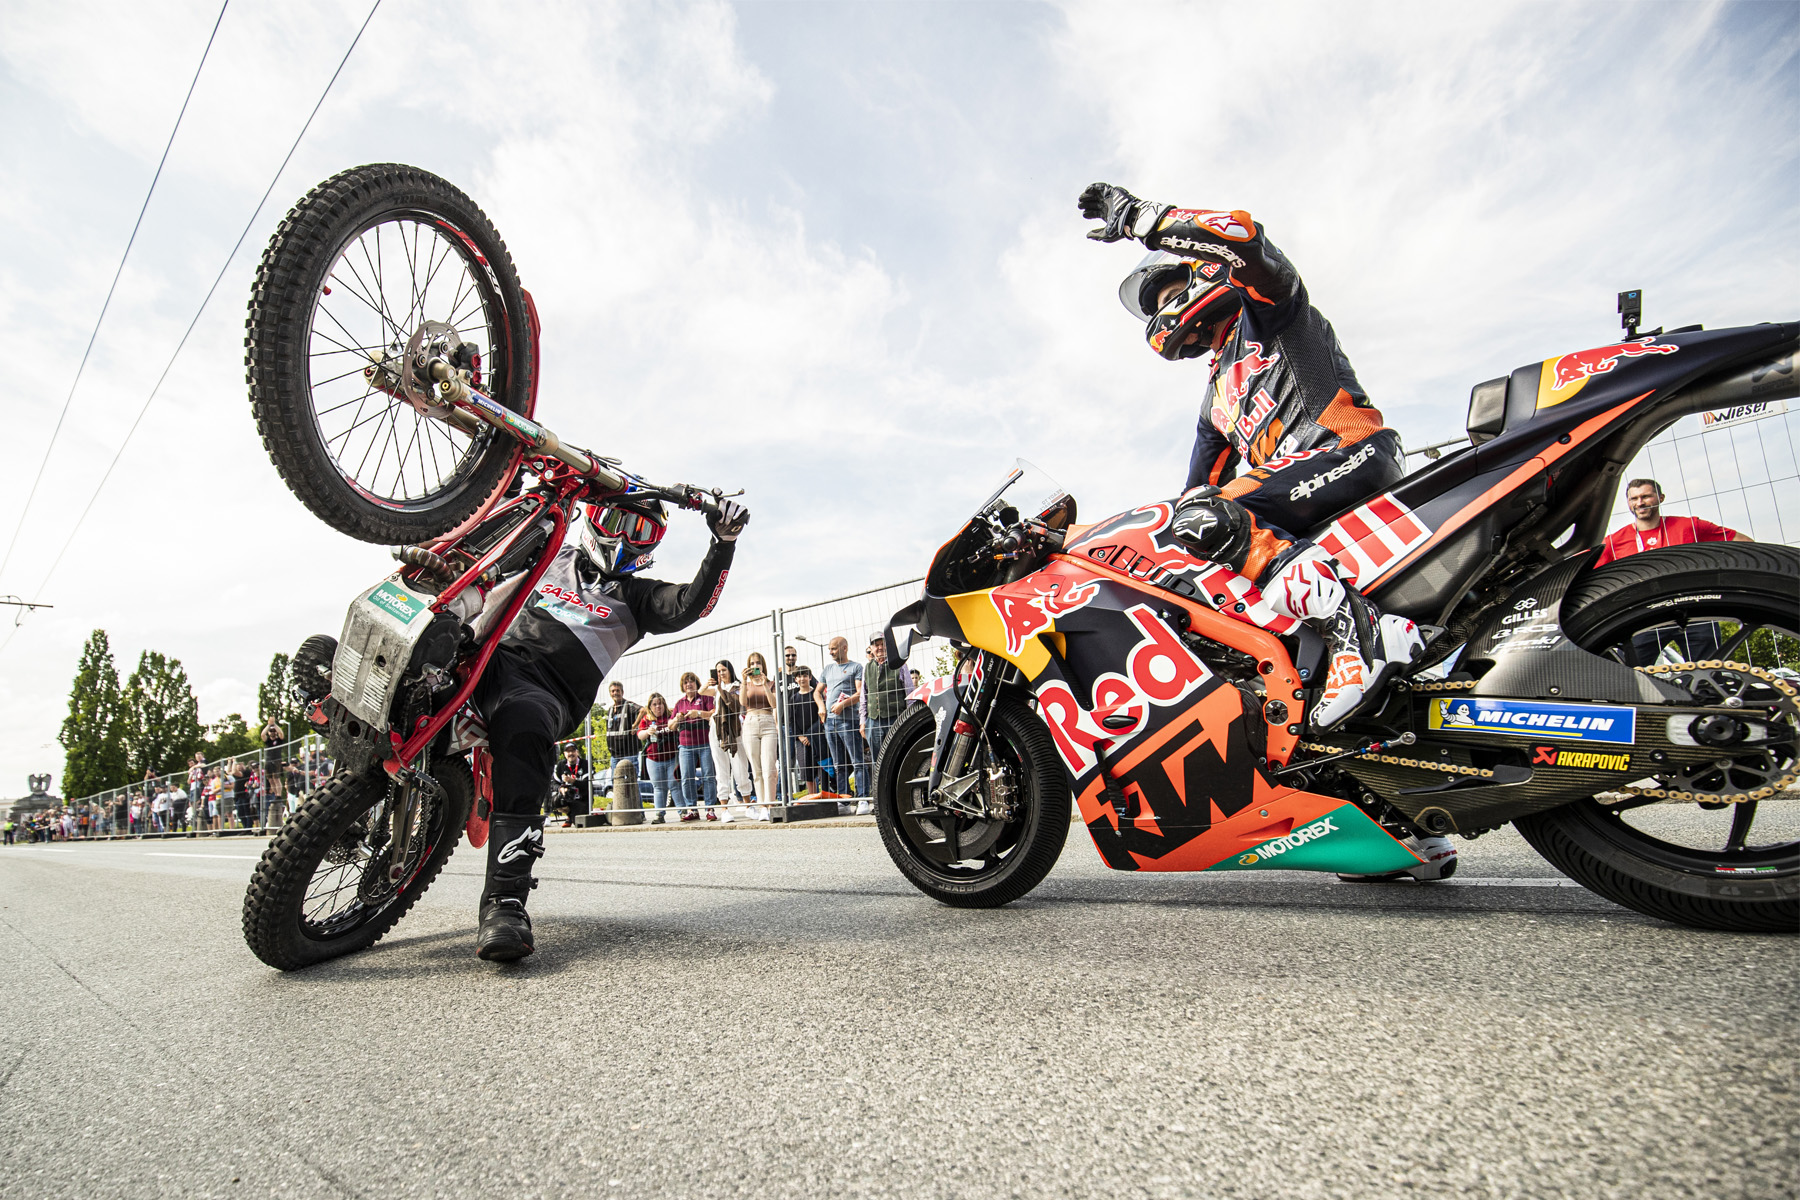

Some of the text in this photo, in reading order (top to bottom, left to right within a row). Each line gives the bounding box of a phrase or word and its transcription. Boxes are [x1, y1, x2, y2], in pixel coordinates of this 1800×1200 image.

[1160, 235, 1246, 268] alpinestars
[1201, 262, 1222, 279] Re
[477, 398, 502, 416] MICHELIN
[1235, 387, 1278, 441] Bull
[1713, 401, 1768, 422] Wieser
[513, 419, 537, 437] MOTOREX
[1289, 443, 1376, 502] alpinestars
[376, 588, 417, 617] MOTOREX
[540, 584, 612, 620] GASGAS
[698, 569, 730, 619] GASGAS
[1673, 594, 1722, 605] marchesini
[385, 602, 411, 621] Switzerland
[1501, 608, 1548, 625] GILLES
[1036, 604, 1212, 779] Red
[1477, 710, 1615, 732] MICHELIN
[1087, 718, 1281, 871] KTM
[1255, 817, 1340, 860] MOTOREX
